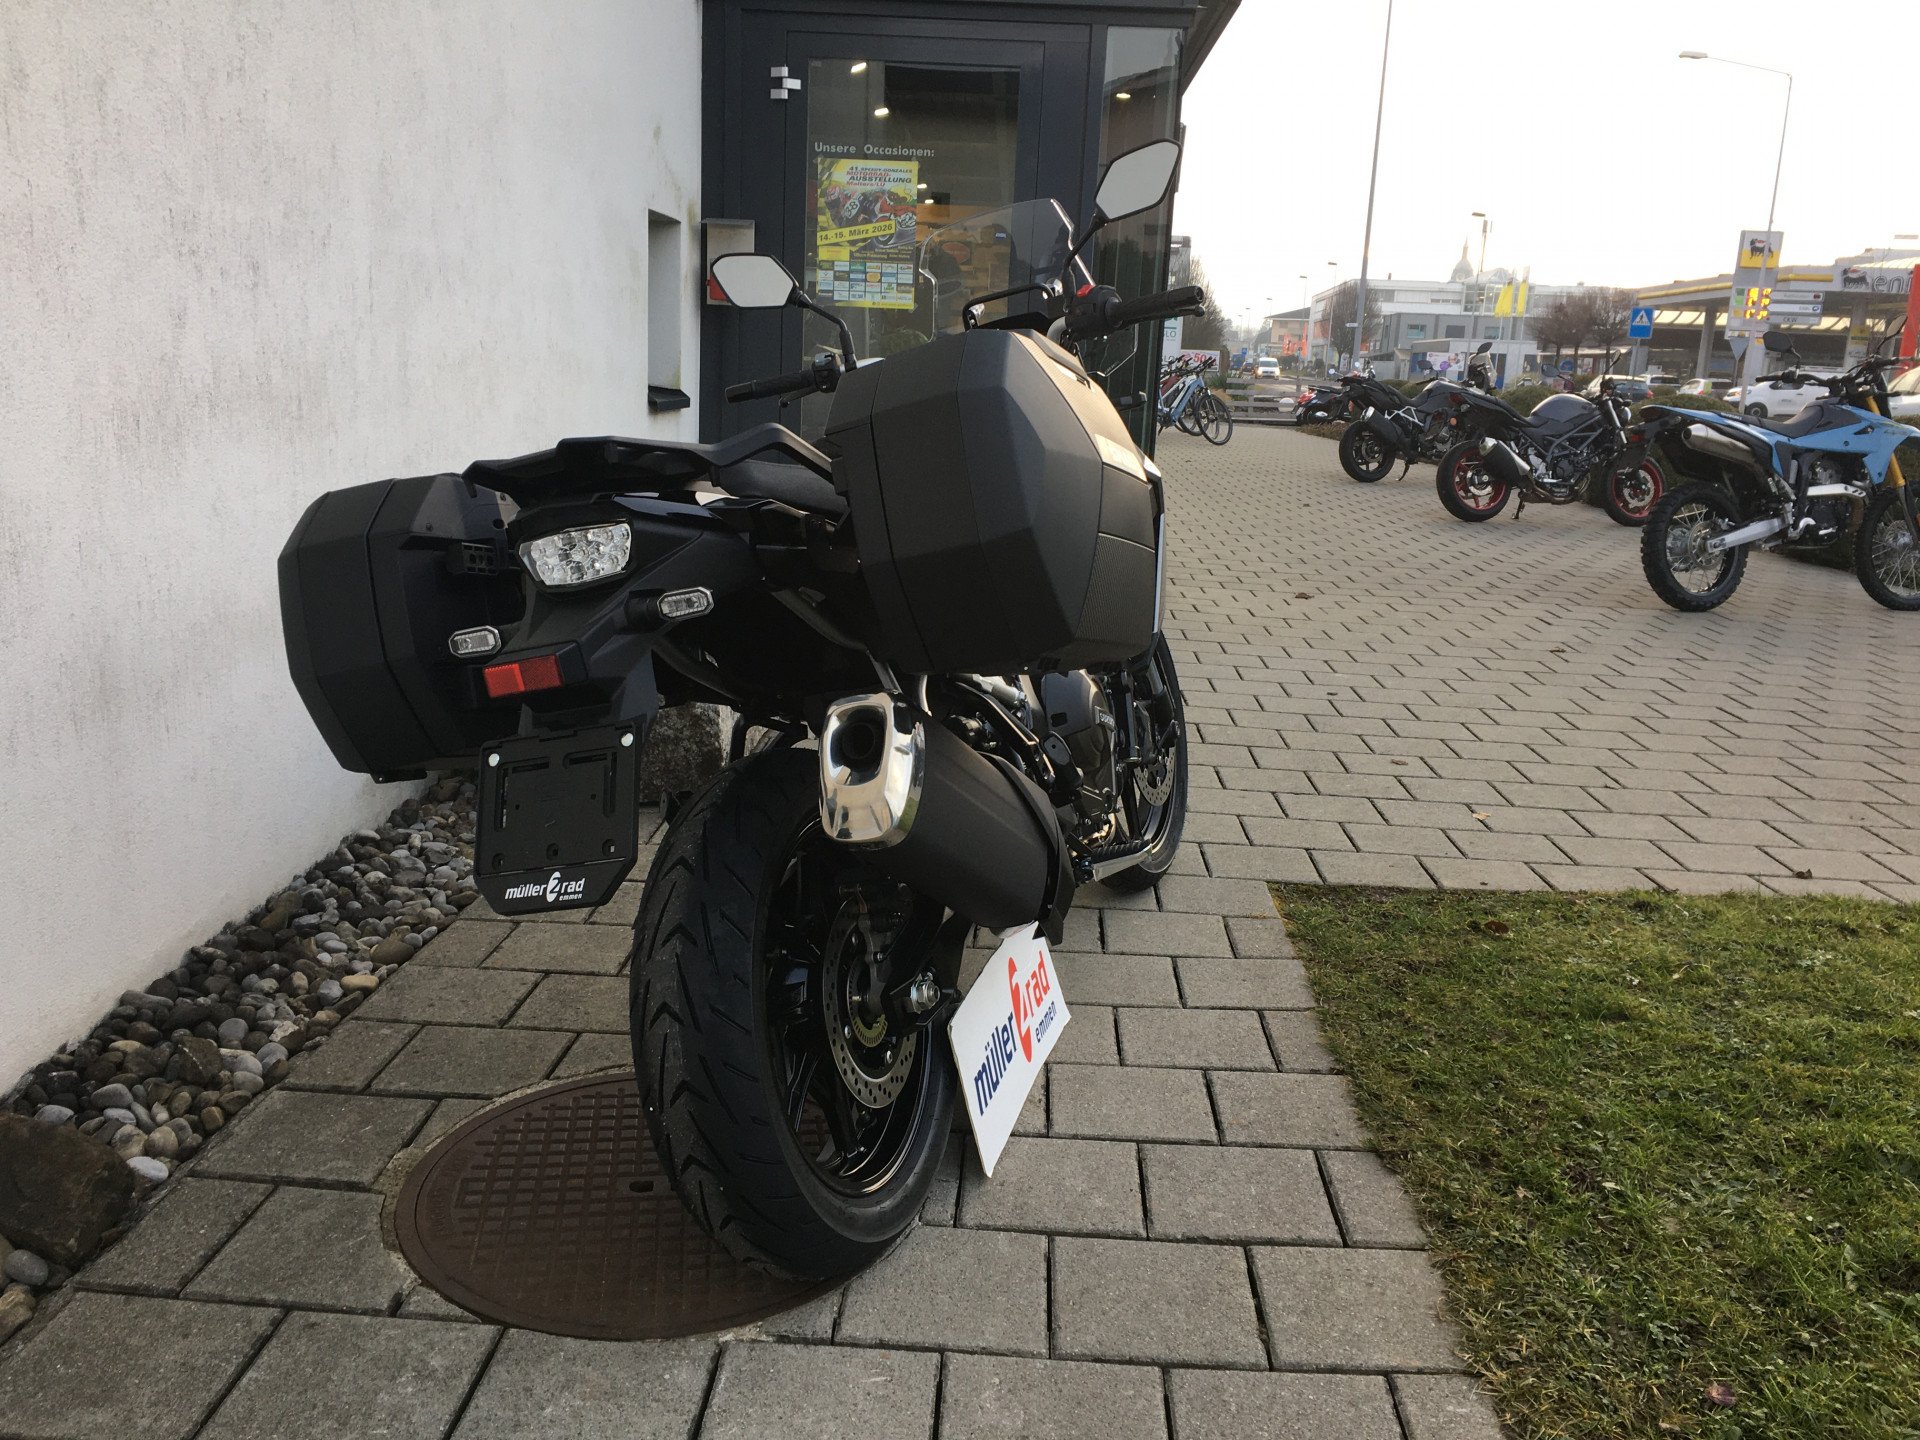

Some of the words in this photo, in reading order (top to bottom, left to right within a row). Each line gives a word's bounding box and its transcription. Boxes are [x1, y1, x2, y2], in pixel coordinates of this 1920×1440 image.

[814, 142, 856, 154] Unsere
[864, 144, 935, 157] Occasionen:
[849, 176, 912, 184] AUSSTELLUNG
[849, 228, 870, 237] März
[872, 223, 893, 233] 2026
[1872, 270, 1913, 294] eni
[505, 884, 546, 900] müller
[559, 893, 583, 901] emmen
[1035, 1000, 1058, 1043] emmen
[973, 1011, 1018, 1117] müller
